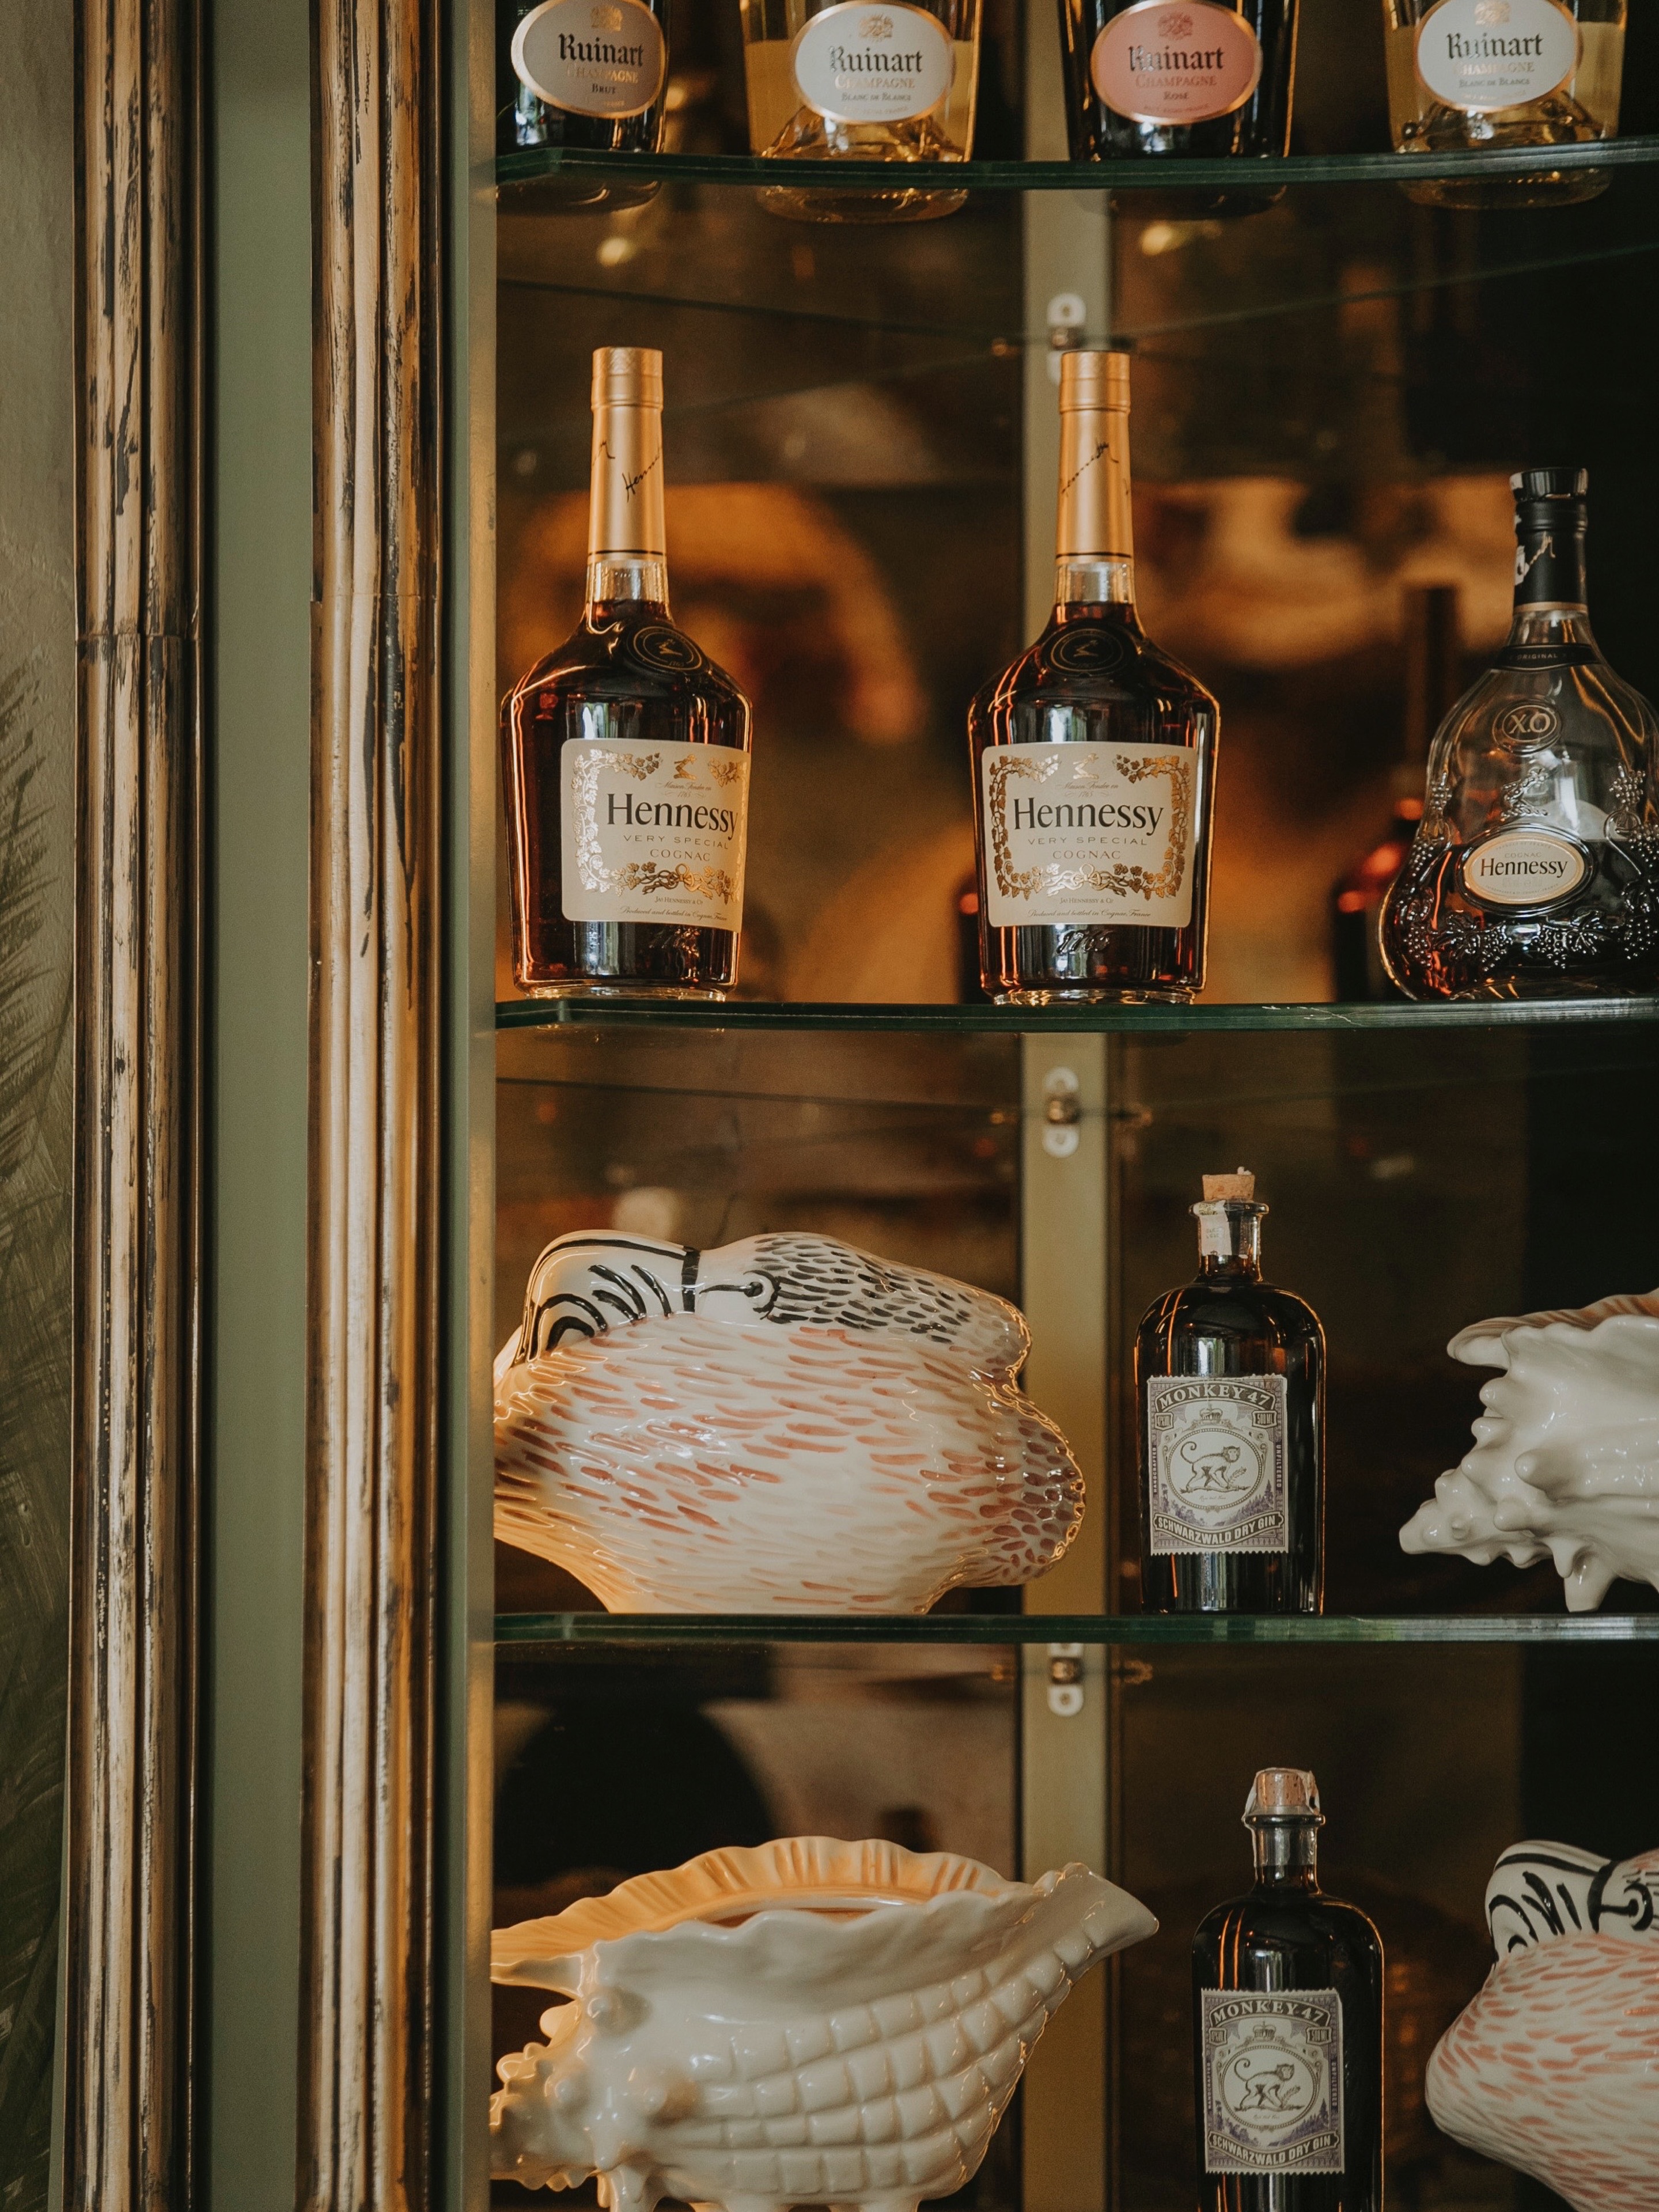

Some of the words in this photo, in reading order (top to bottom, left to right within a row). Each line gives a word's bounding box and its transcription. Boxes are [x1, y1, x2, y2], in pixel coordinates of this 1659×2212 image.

[559, 33, 644, 67] Ruinart
[1129, 45, 1224, 71] Ruinart
[1446, 32, 1543, 59] Ruinart
[830, 46, 923, 74] Ruinart
[592, 84, 616, 94] BRUT
[1135, 74, 1218, 87] CHAMPAGNE
[607, 793, 738, 840] Hennessy
[1014, 797, 1164, 836] Hennessy
[623, 835, 666, 843] VERY
[673, 836, 729, 849] SPECIAL
[1028, 836, 1067, 846] VERY
[1076, 836, 1148, 846] SPECIAL
[650, 849, 711, 862] COGNAC
[1052, 850, 1121, 860] COGNAC
[1480, 858, 1568, 878] Hennessy
[620, 906, 651, 915] Produced
[1028, 908, 1056, 918] Produced
[1128, 908, 1151, 917] France
[1159, 1385, 1245, 1410] MONKEY
[1247, 1392, 1271, 1406] 47
[1158, 1517, 1232, 1546] SCHWARZWALD
[1234, 1522, 1256, 1542] DRY
[1257, 1514, 1276, 1529] GIN
[1213, 1999, 1299, 2024] MONKEY
[1301, 2008, 1324, 2022] 47
[1212, 2134, 1286, 2166] SCHWARZWALD
[1289, 2142, 1310, 2162] DRY
[1313, 2136, 1331, 2151] GIN
